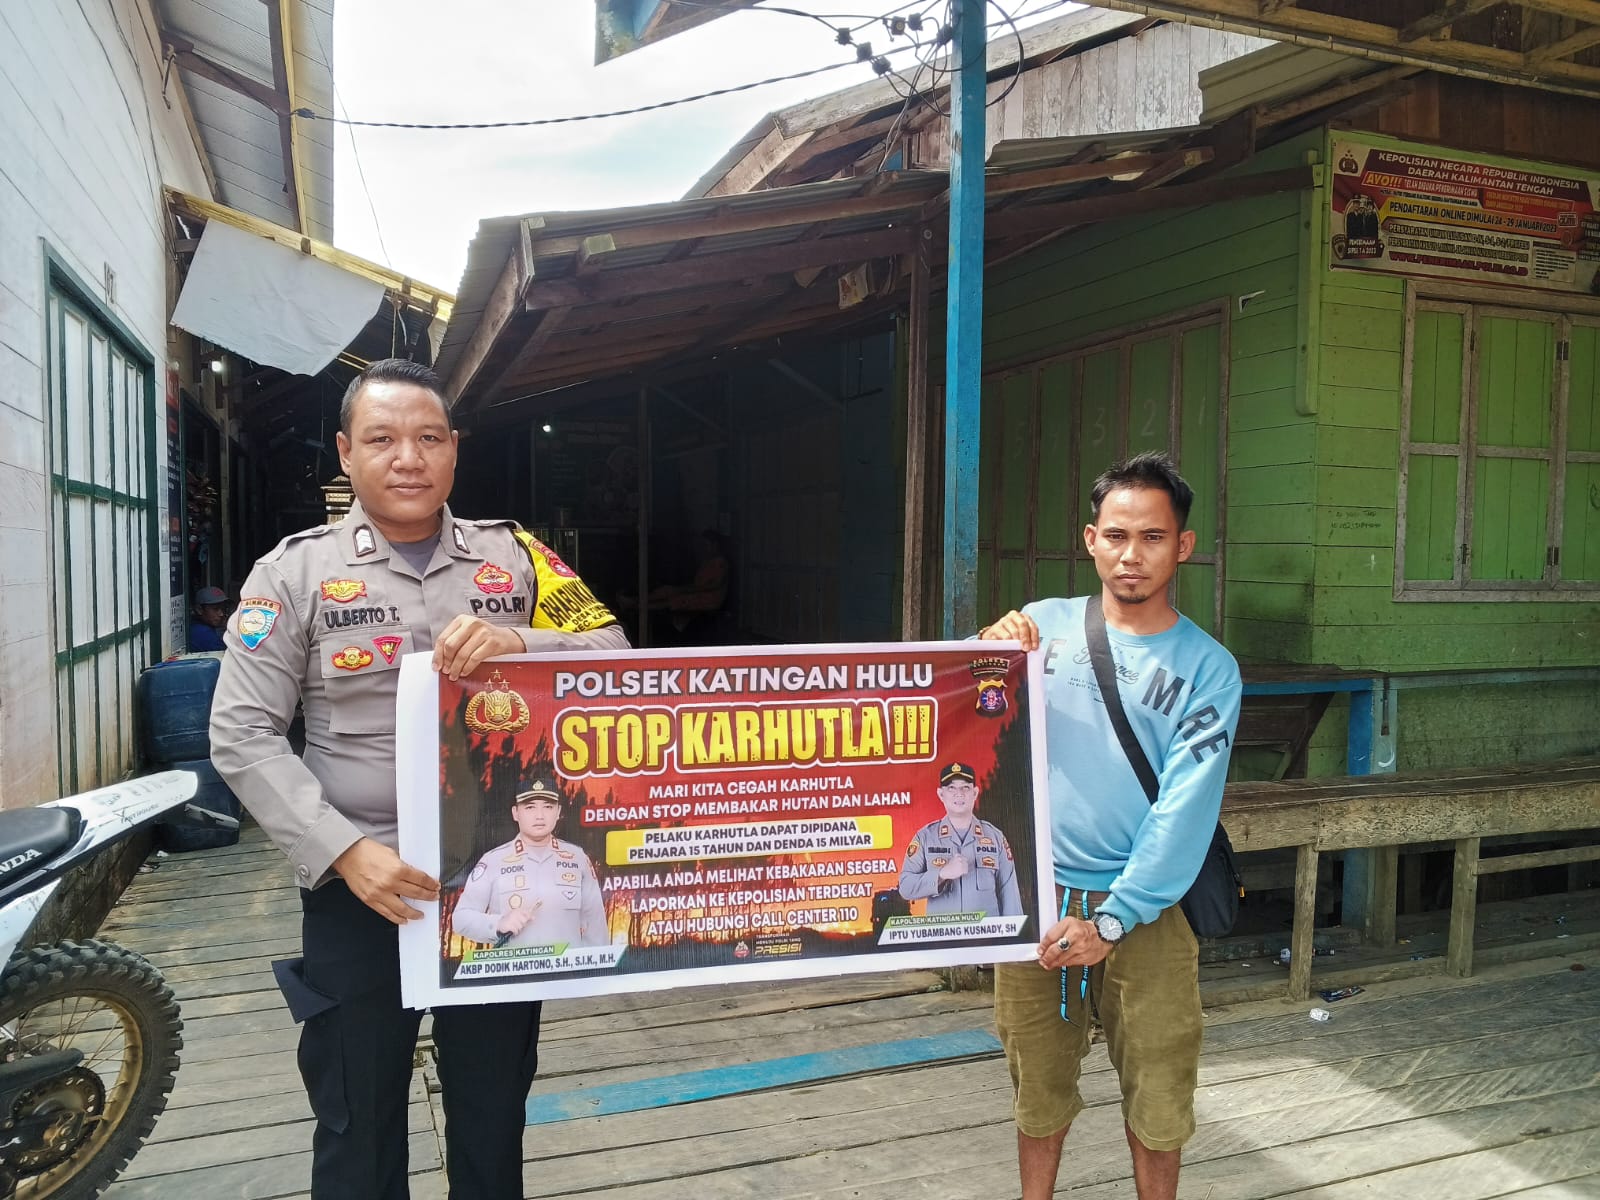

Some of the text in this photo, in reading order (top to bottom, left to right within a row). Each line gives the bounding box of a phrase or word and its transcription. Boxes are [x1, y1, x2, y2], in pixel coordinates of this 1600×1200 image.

[1378, 152, 1580, 190] KEPOLISIAN NEGARA REPUBLIK INDONESIA
[1408, 166, 1554, 196] DAERAH KALIMANTAN TENGAH
[1390, 201, 1438, 217] PENDAFTARAN
[1441, 208, 1466, 221] ONLINE
[1466, 212, 1494, 224] DIMULAI
[1516, 219, 1542, 232] JANUARI
[1141, 398, 1157, 437] 2
[324, 606, 400, 629] ULBERTO T.
[469, 596, 526, 614] POLRI
[556, 663, 933, 698] POLSEK KATINGAN HULU
[1141, 667, 1230, 765] MRE
[560, 704, 932, 772] STOP KARHUTLA !!!
[650, 776, 854, 800] MARI KITA CEGAH KARHUTLA
[585, 792, 911, 823] DENGAN STOP MEMBAKAR HUTAN DAN LAHAN
[646, 820, 856, 844] PELAKU KARHUTLA DAPAT DIPIDANA
[630, 834, 872, 860] PENJARA 15 TAHUN DAN DENDA 15 MILYAR
[976, 846, 996, 854] POLRI
[0, 848, 42, 875] NDA
[500, 865, 524, 875] DODIK
[556, 860, 579, 870] POLRI
[604, 860, 897, 891] APABILA ANDA MELIHAT KEBAKARAN SEGERA
[631, 883, 873, 914] LAPORKAN KE KEPOLISIAN TERDEKAT
[648, 908, 858, 936] ATAU HUBUNGI CALL CENTER 110
[890, 914, 980, 926] KAPOLSEK KATINGAN HULU
[890, 923, 1016, 940] IPTU YUBAMBANG KUSNADY, SH
[474, 946, 554, 960] KAPOLRES KATINGAN
[755, 943, 802, 954] PRESISI
[460, 954, 616, 975] AKBP DODIK HARTONO, S.H., S.I.K., M.H.
